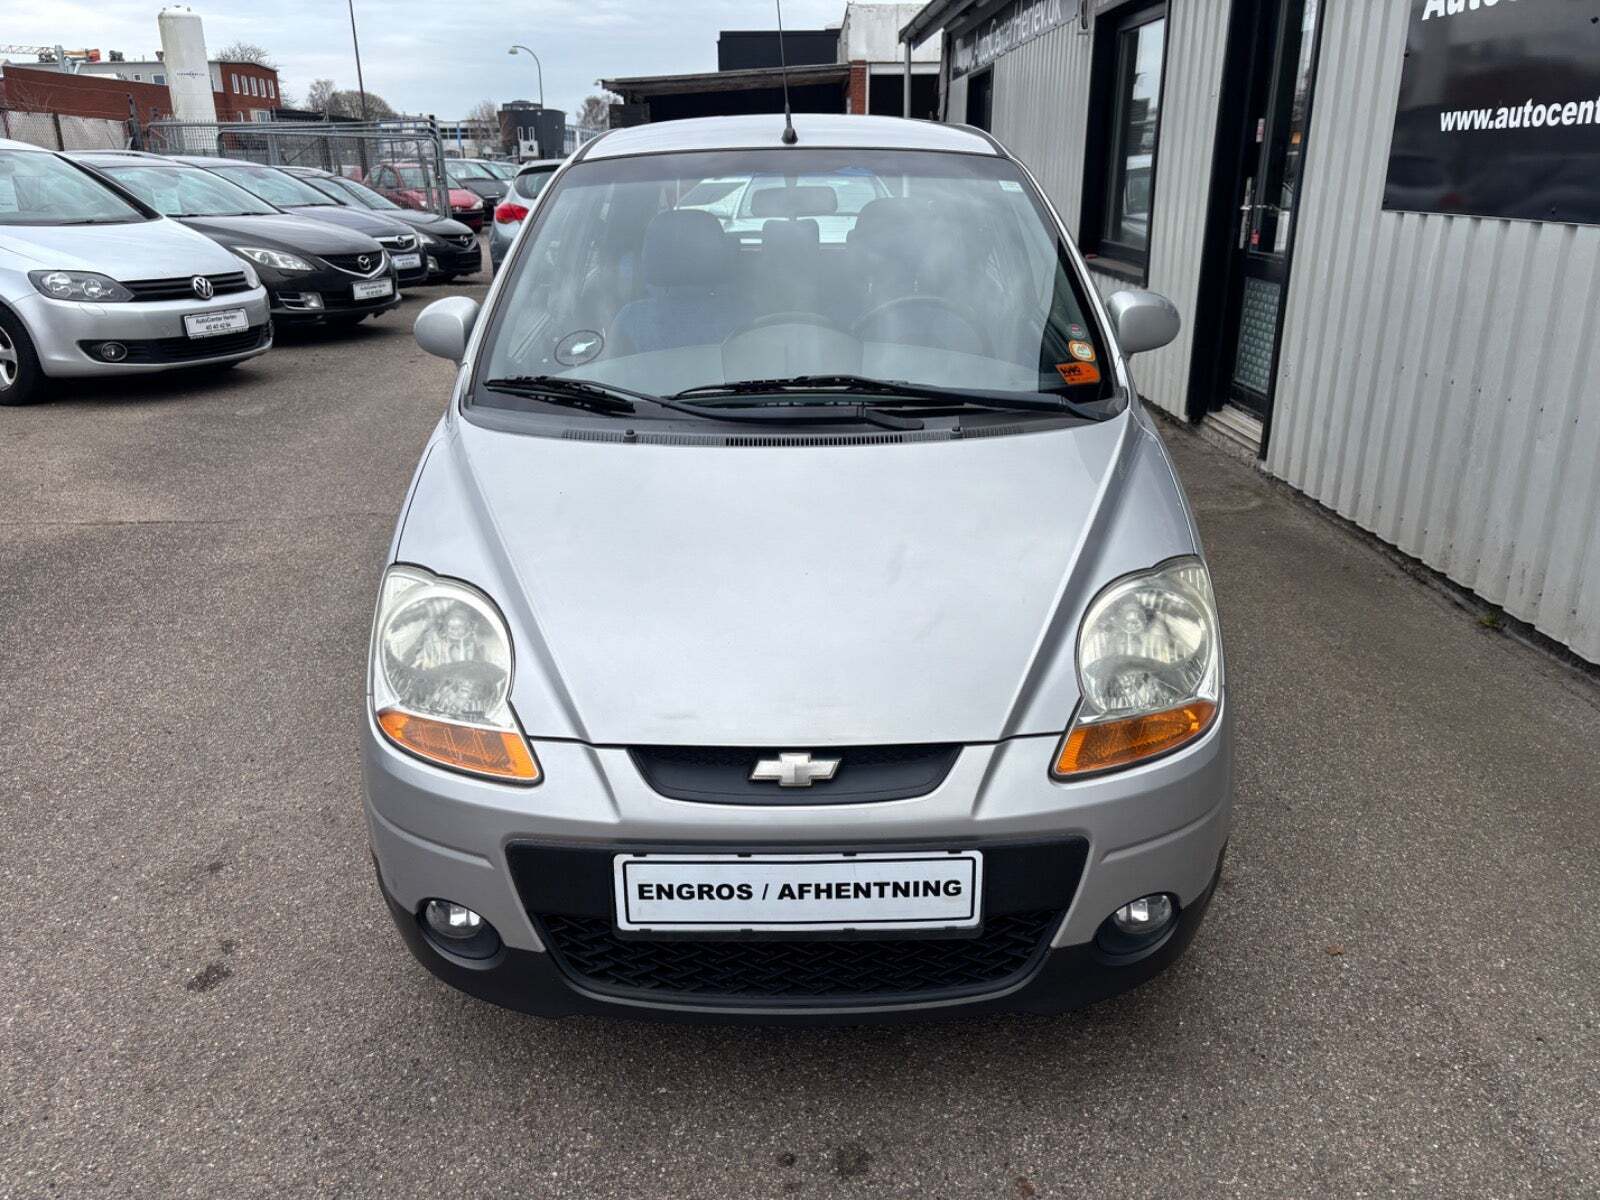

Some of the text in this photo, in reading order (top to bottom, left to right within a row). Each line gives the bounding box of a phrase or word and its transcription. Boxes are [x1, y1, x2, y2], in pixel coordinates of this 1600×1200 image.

[637, 879, 963, 901] ENGROS / AFHENTNING
